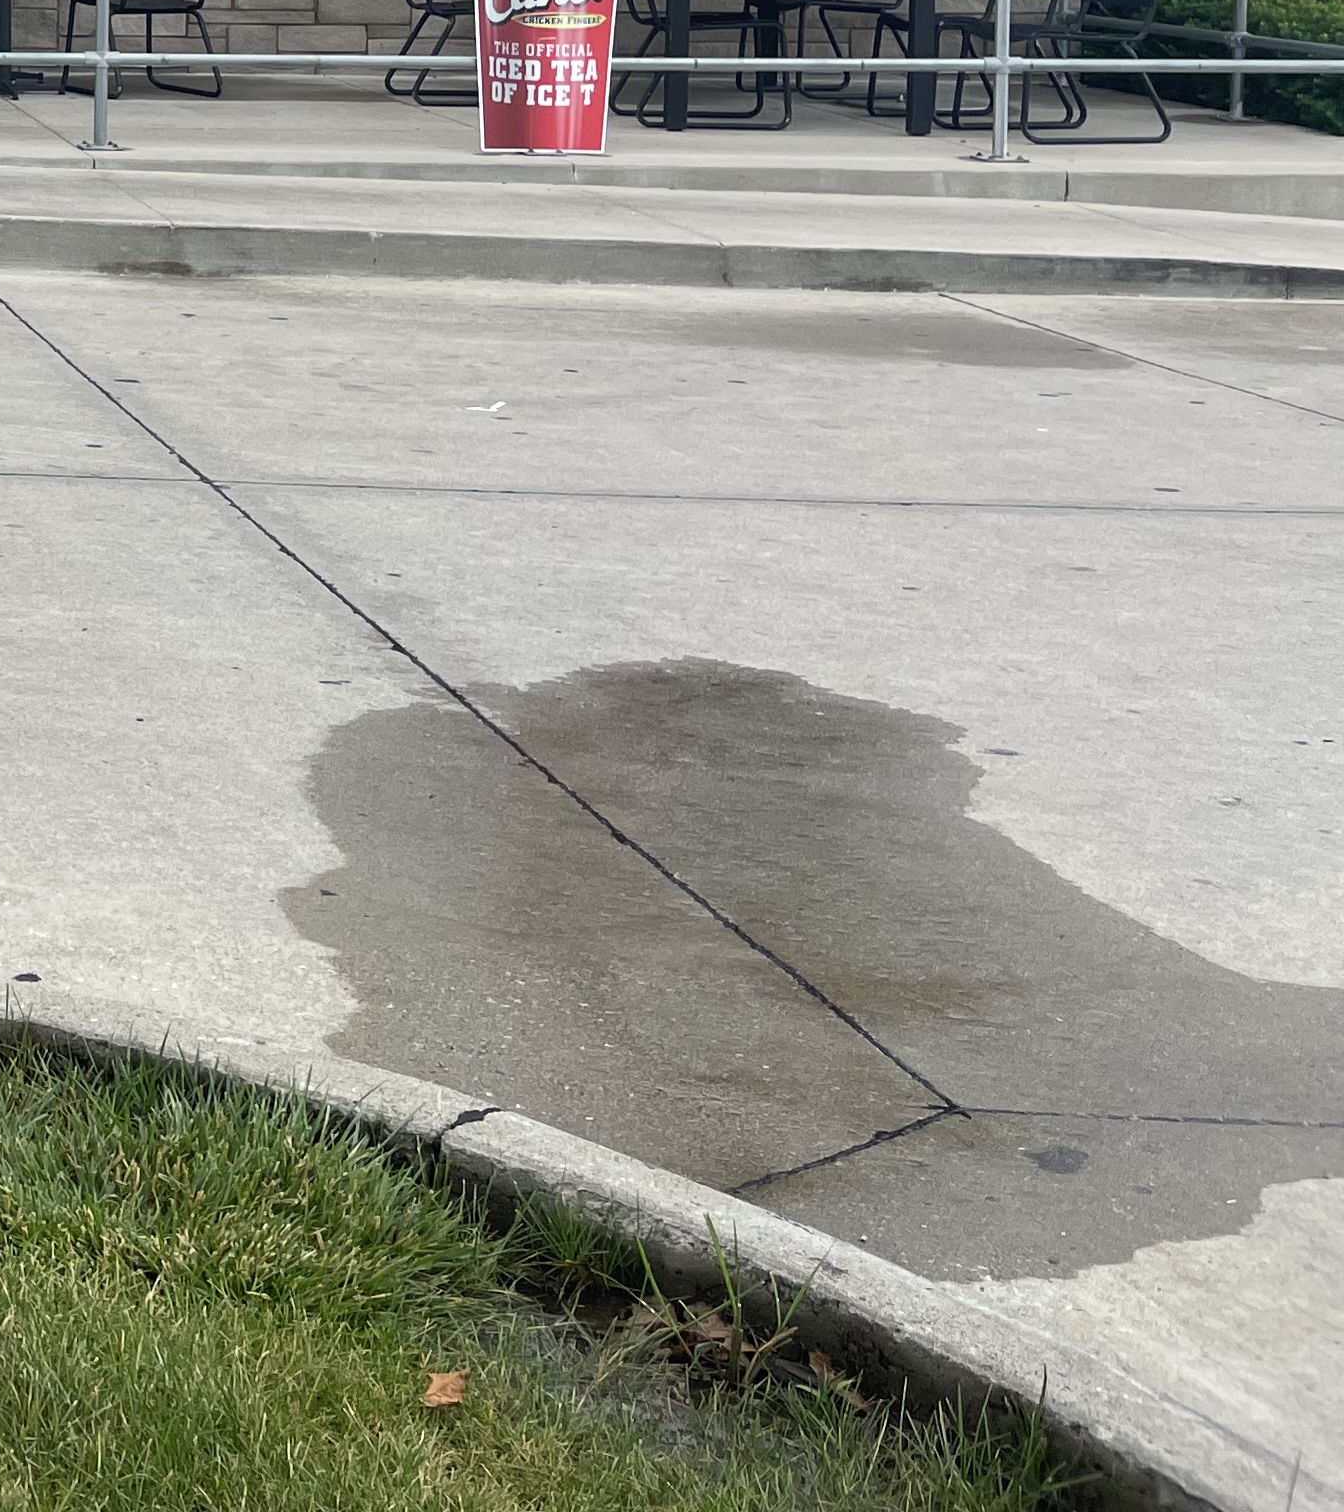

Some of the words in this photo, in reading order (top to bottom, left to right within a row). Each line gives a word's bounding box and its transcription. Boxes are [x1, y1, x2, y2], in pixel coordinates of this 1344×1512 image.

[493, 40, 520, 56] THE
[525, 42, 593, 57] OFFICIAL
[488, 55, 542, 82] ICED
[550, 59, 599, 82] TEA
[491, 81, 518, 104] OF
[526, 84, 571, 106] ICE
[580, 83, 595, 106] T
